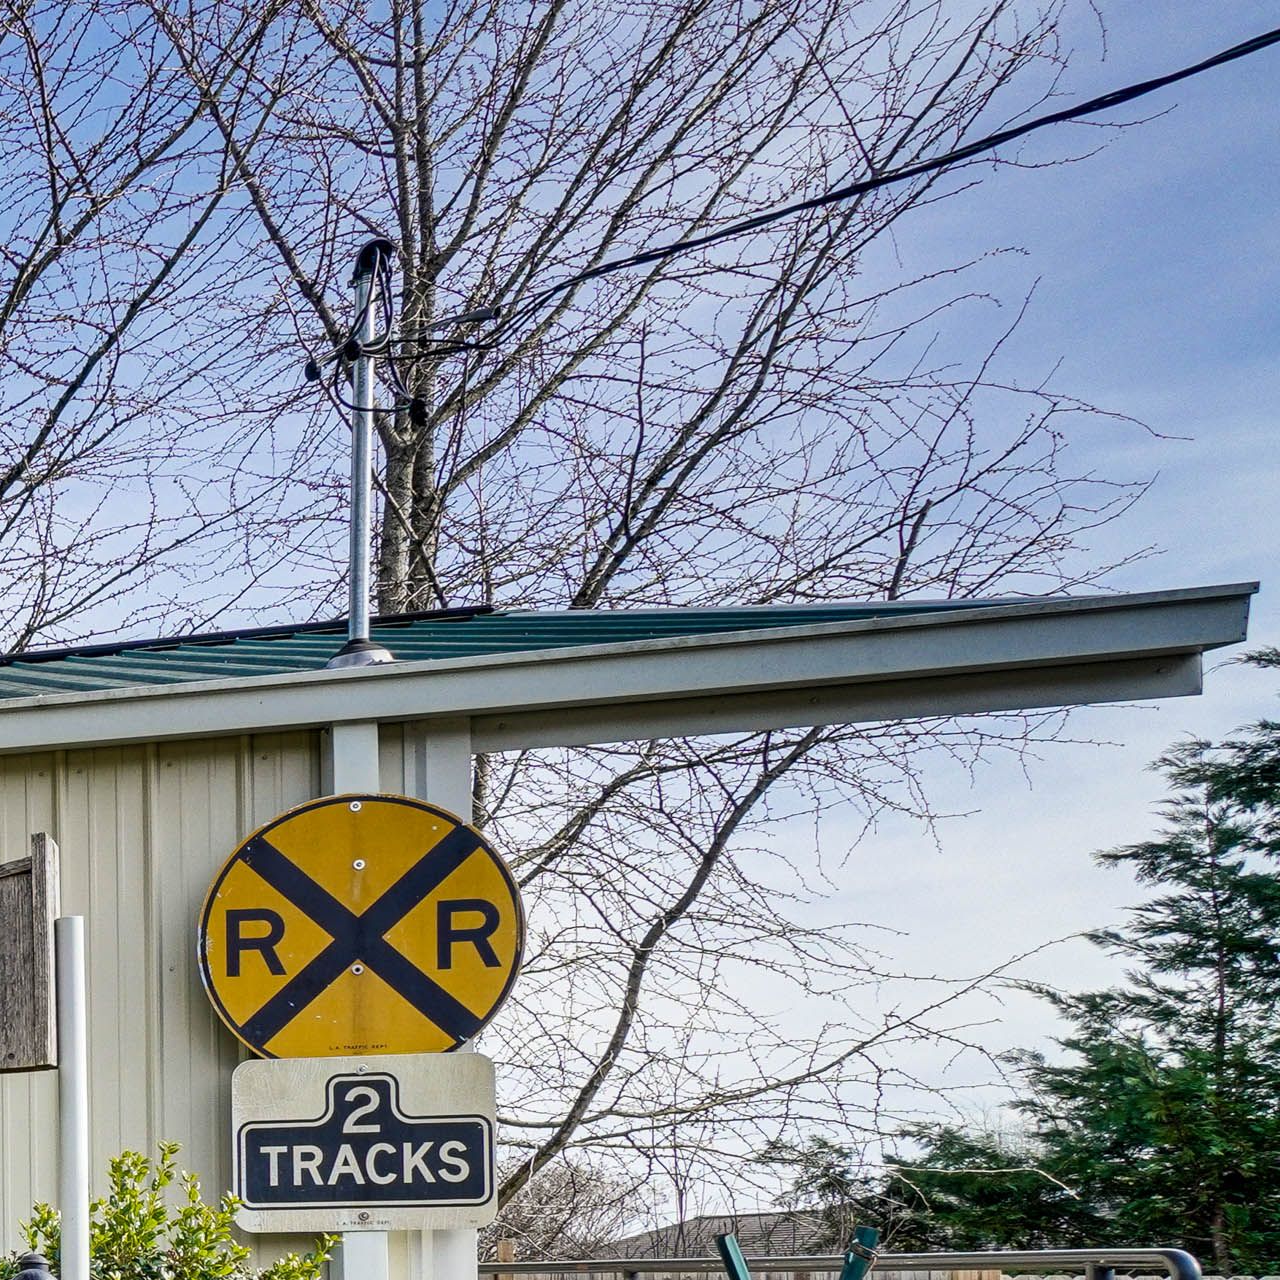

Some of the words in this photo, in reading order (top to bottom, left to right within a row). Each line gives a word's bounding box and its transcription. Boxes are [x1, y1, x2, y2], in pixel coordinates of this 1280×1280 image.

[226, 908, 287, 977] R
[437, 898, 502, 969] R
[342, 1086, 381, 1134] 2
[259, 1140, 470, 1187] TRACKS
